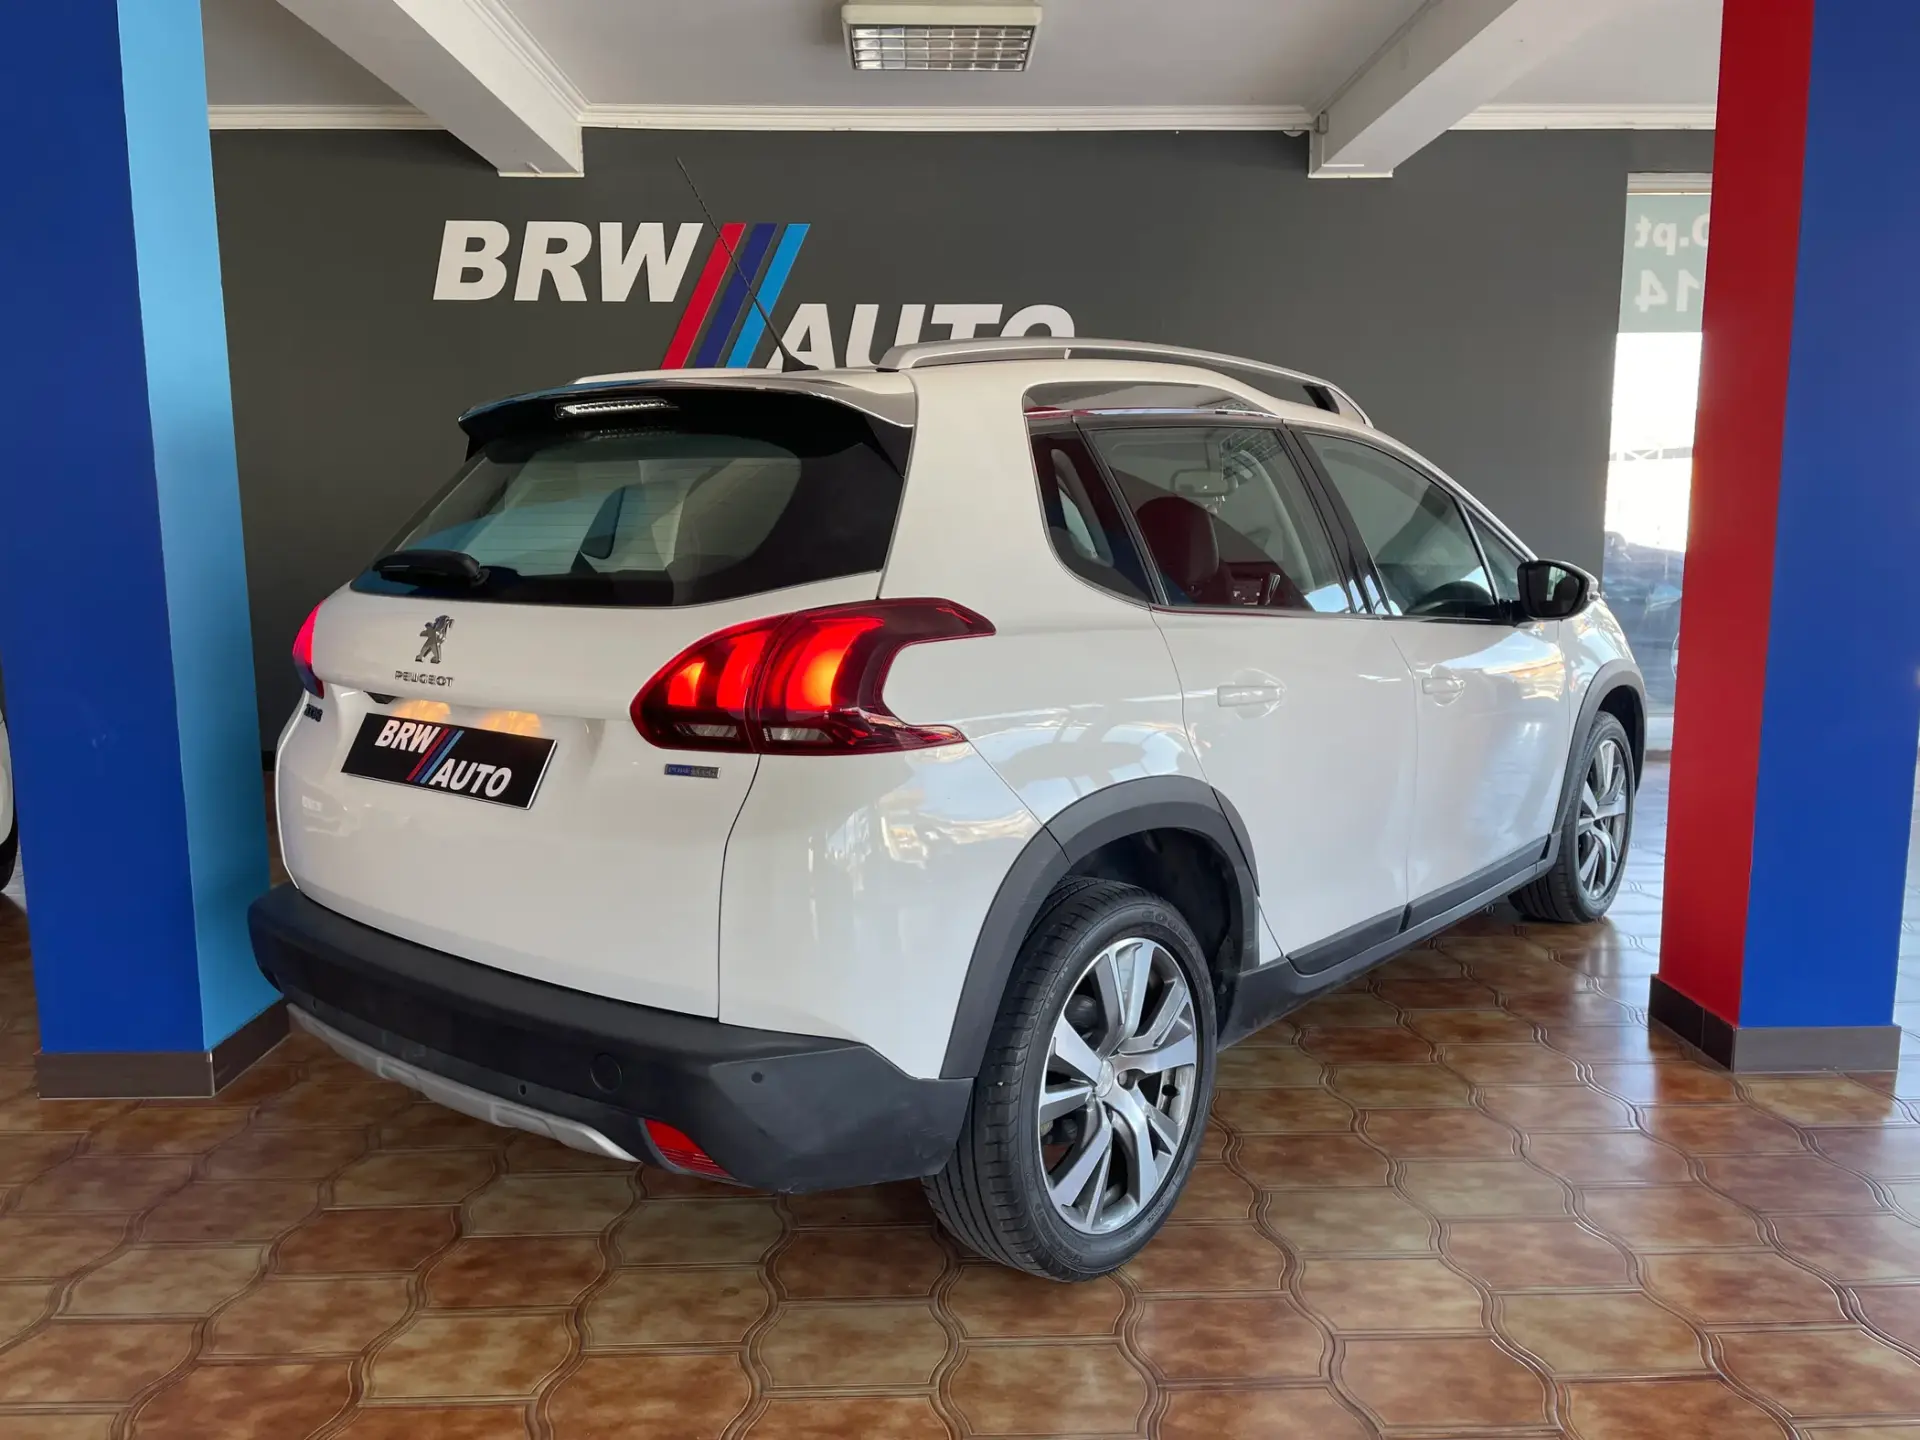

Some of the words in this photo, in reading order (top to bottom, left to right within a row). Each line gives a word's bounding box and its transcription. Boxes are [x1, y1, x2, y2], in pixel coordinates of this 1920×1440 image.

[433, 220, 704, 303] BRW
[395, 670, 454, 687] PEUGEOT
[374, 719, 441, 754] BRW
[428, 758, 512, 798] AUTO
